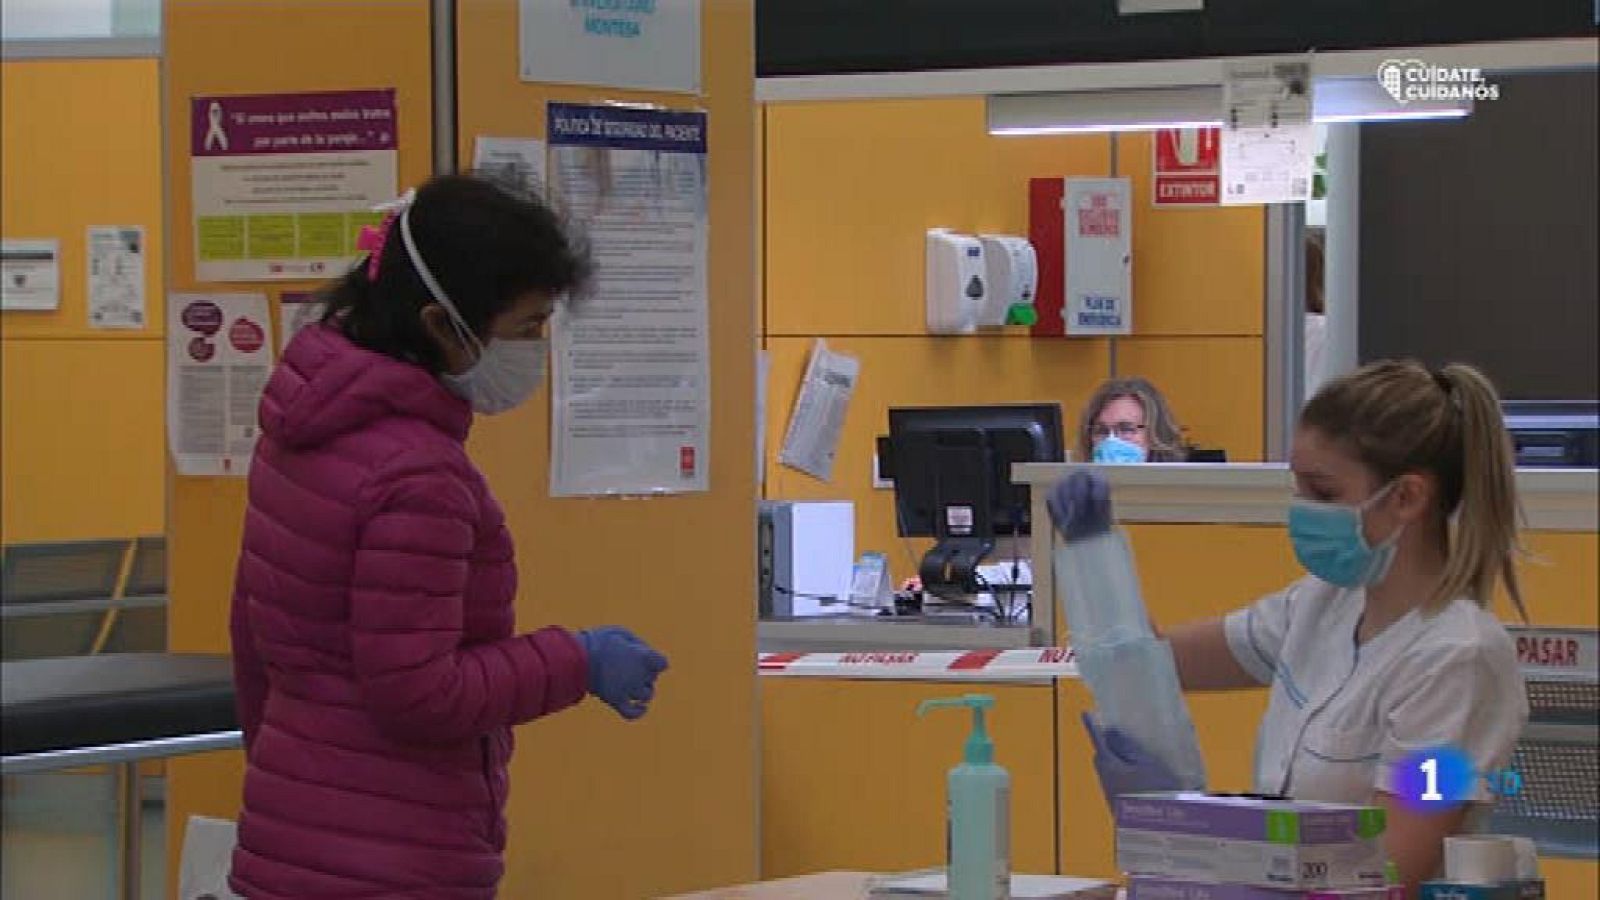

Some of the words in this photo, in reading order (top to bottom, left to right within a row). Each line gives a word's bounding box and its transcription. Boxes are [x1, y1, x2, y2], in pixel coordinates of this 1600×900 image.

[1159, 183, 1217, 199] EXTINTOR
[1037, 649, 1063, 664] NO
[1516, 636, 1580, 667] PASAR
[1302, 861, 1329, 877] 200
